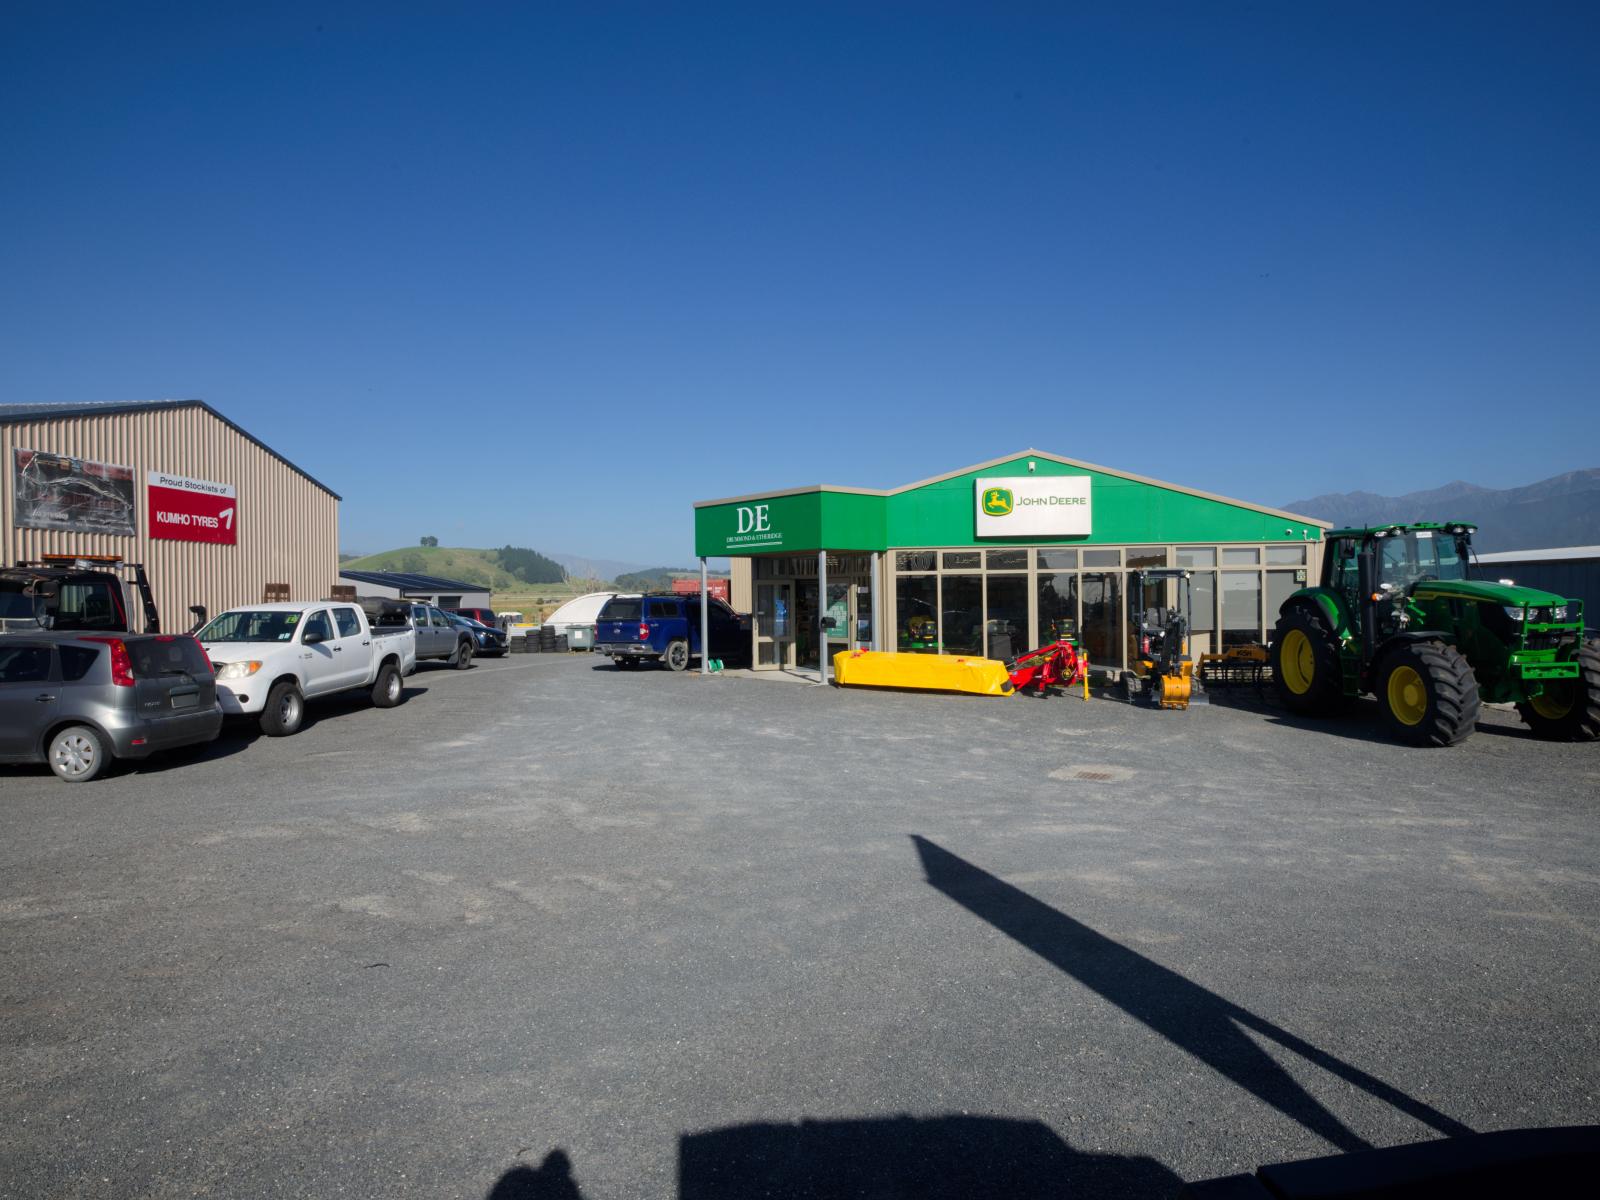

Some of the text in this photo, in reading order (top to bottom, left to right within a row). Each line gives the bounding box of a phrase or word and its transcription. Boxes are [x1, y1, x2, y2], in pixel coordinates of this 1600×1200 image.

[160, 476, 183, 487] Proud
[184, 480, 218, 493] Stockists
[156, 511, 219, 529] KUMHO TYRES
